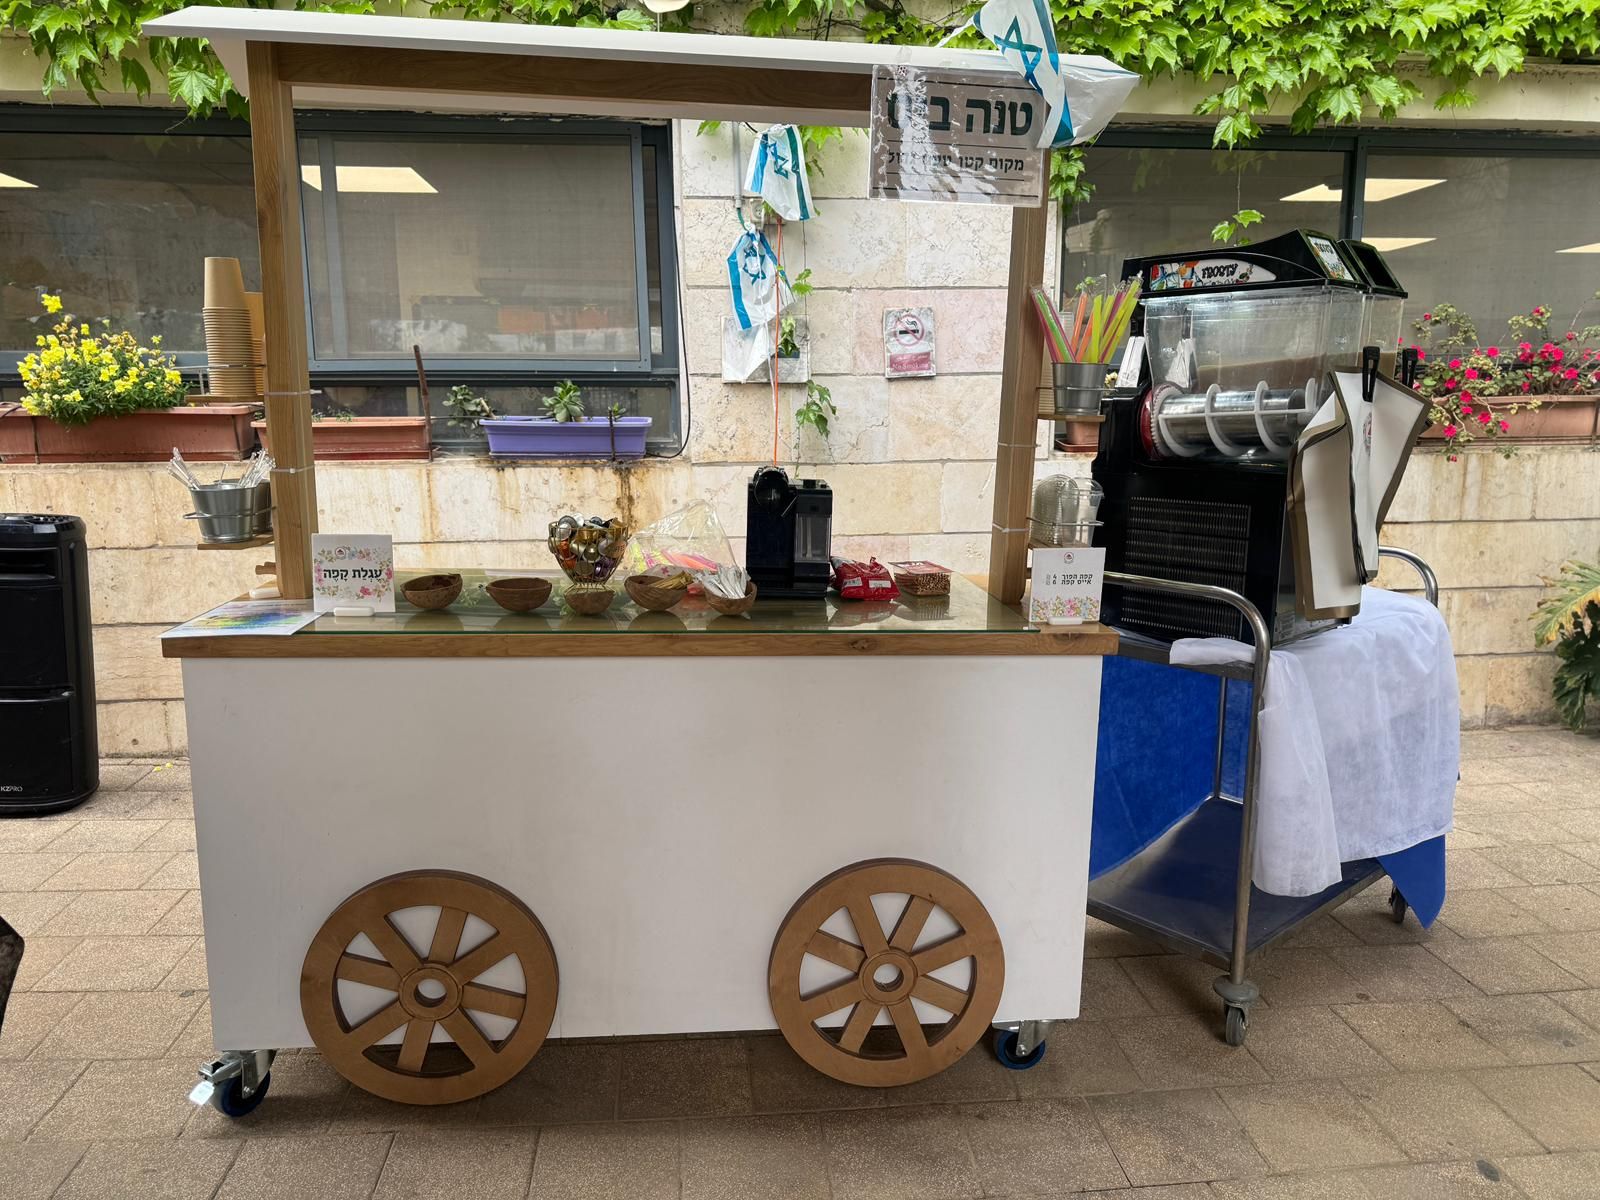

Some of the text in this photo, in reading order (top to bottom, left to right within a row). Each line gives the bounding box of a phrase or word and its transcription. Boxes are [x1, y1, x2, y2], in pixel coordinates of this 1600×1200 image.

[965, 98, 1033, 136] טנה
[989, 157, 1024, 173] מקום
[1202, 262, 1239, 279] FROSTY
